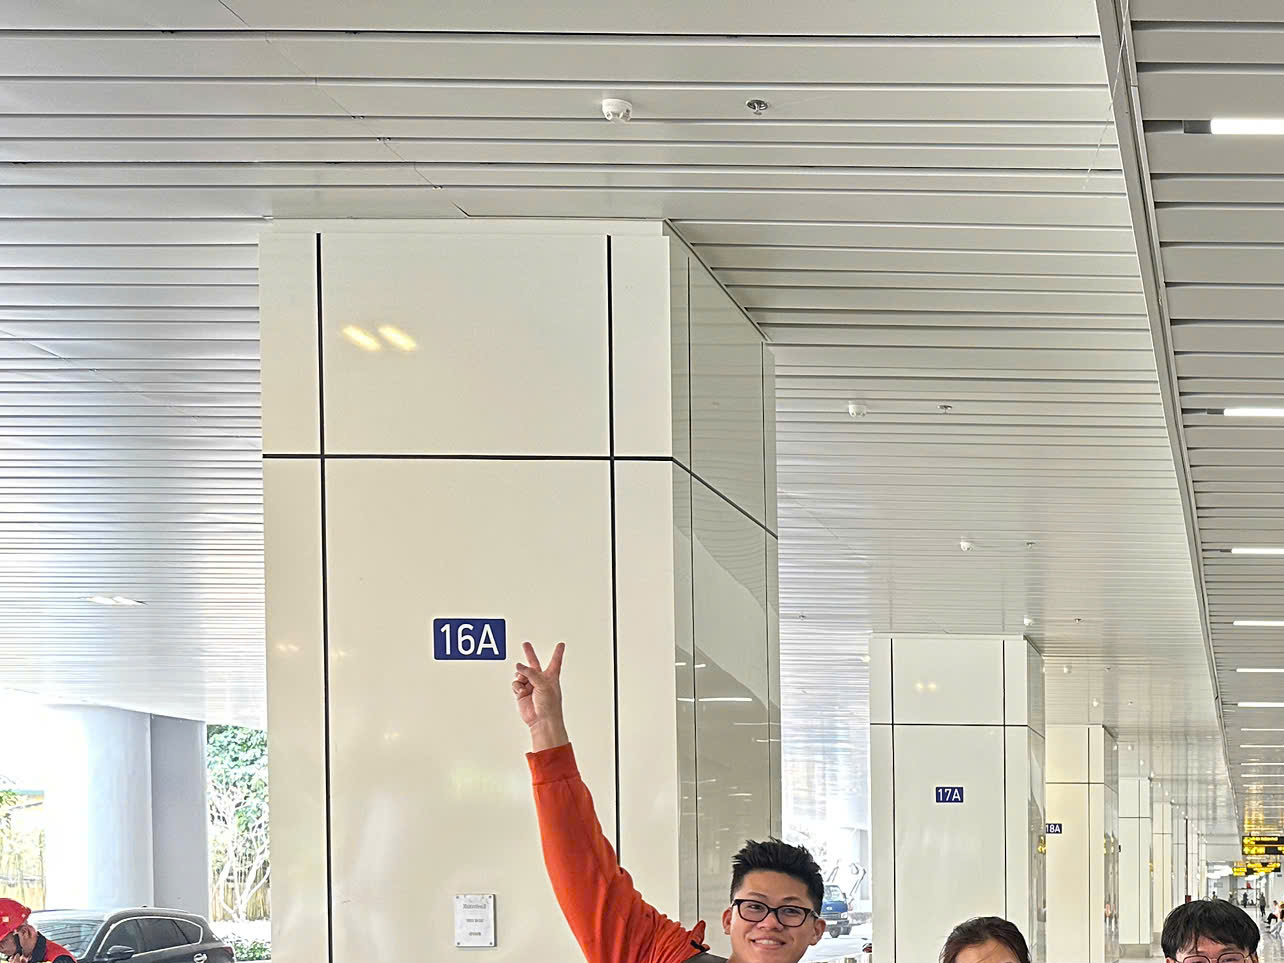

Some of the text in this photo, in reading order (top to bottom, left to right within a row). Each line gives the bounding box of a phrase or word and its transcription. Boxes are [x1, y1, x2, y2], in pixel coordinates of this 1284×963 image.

[440, 623, 499, 655] 16A
[938, 789, 961, 802] 17A
[1046, 824, 1061, 833] 18A
